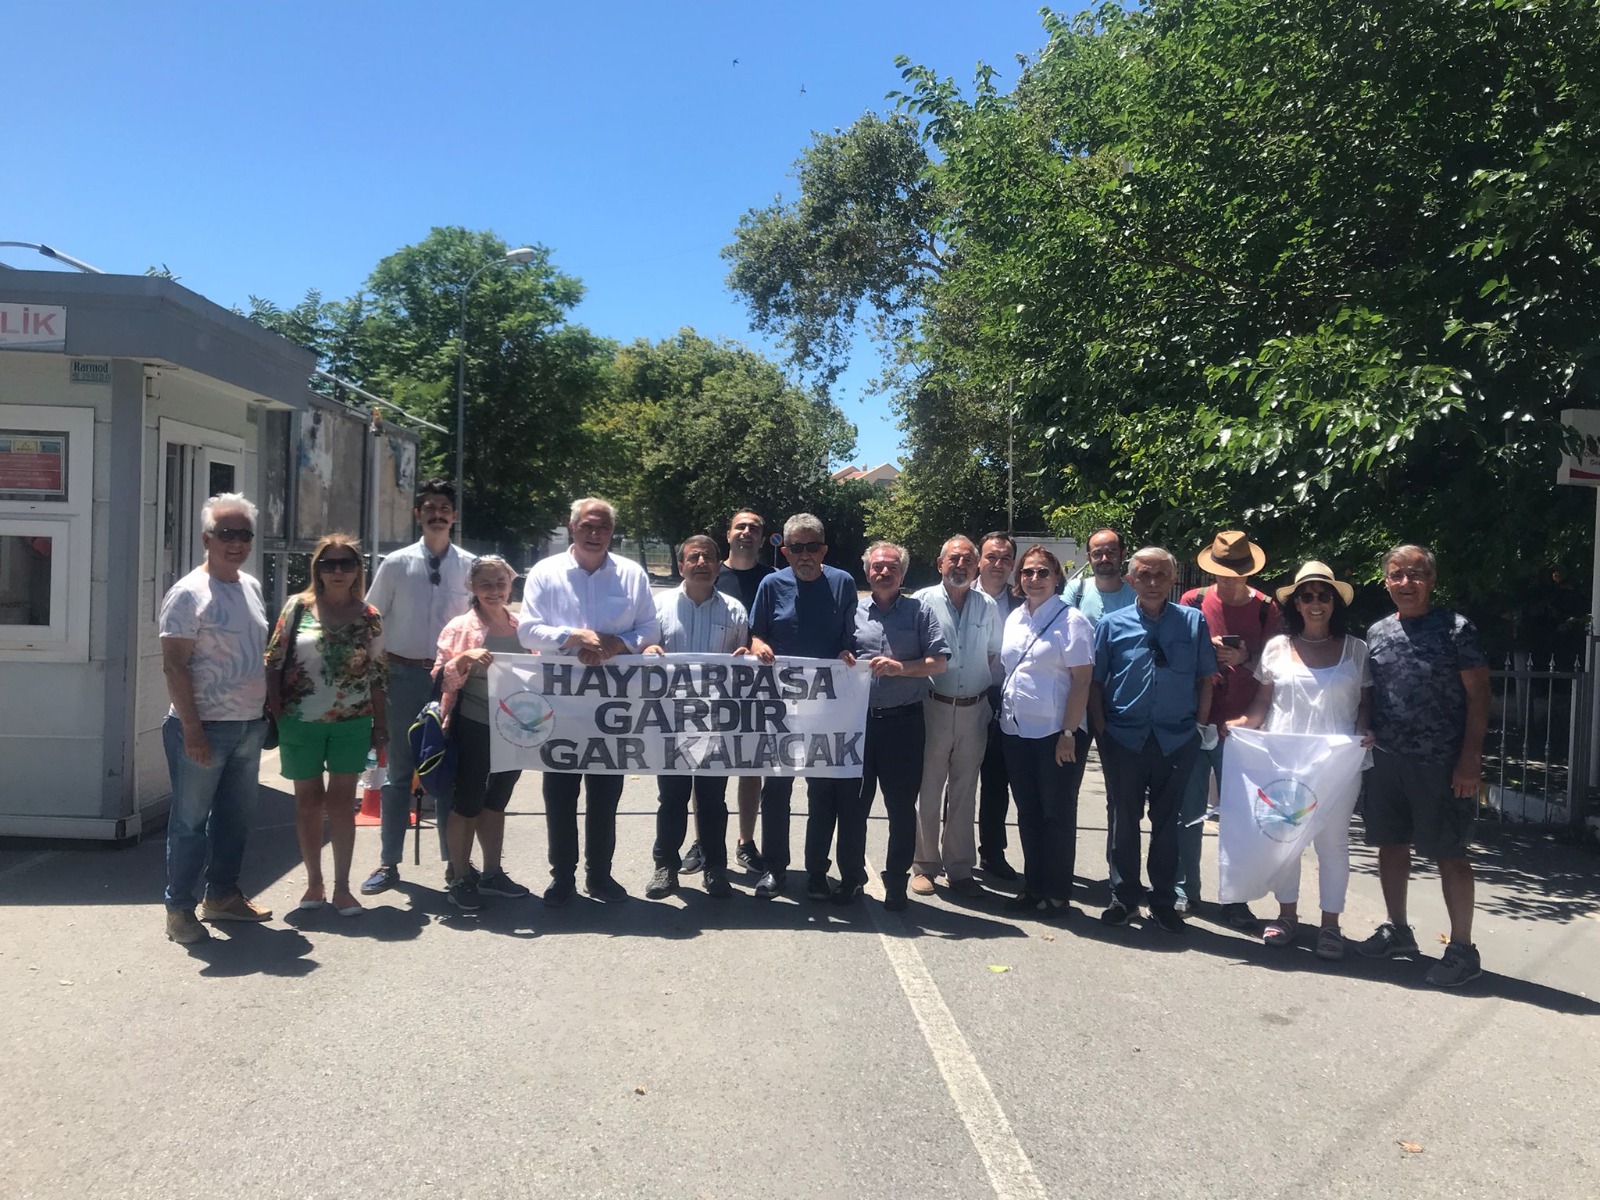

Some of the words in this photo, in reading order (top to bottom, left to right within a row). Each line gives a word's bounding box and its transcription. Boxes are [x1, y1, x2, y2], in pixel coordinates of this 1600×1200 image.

[594, 699, 790, 735] GARDIR
[539, 737, 650, 771] GAR
[663, 731, 864, 771] KALACAK
